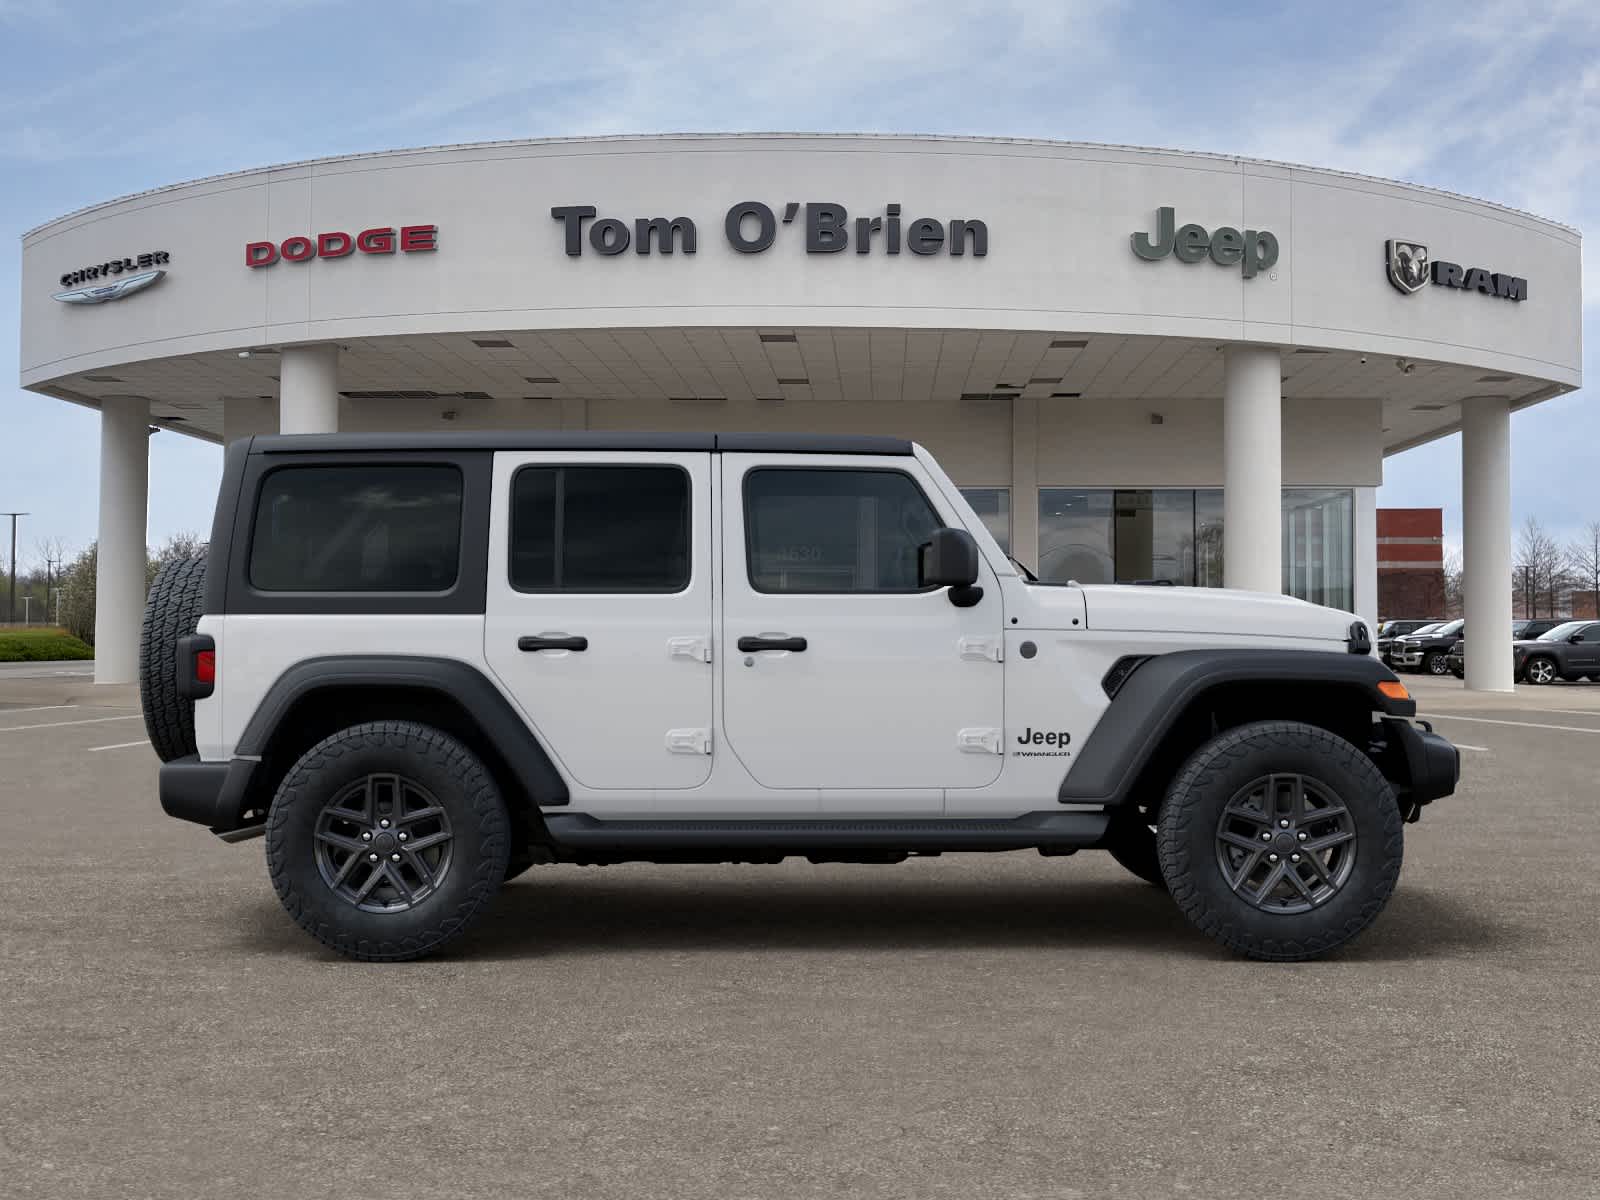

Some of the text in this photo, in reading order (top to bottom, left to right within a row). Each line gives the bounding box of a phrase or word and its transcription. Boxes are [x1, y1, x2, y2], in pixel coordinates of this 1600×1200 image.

[245, 225, 438, 268] DODGE
[551, 201, 988, 256] Tom O'Brien
[1130, 206, 1279, 279] Jeep
[60, 251, 169, 287] CHRYSLER
[1431, 260, 1527, 302] RAM
[1017, 727, 1071, 749] Jeep
